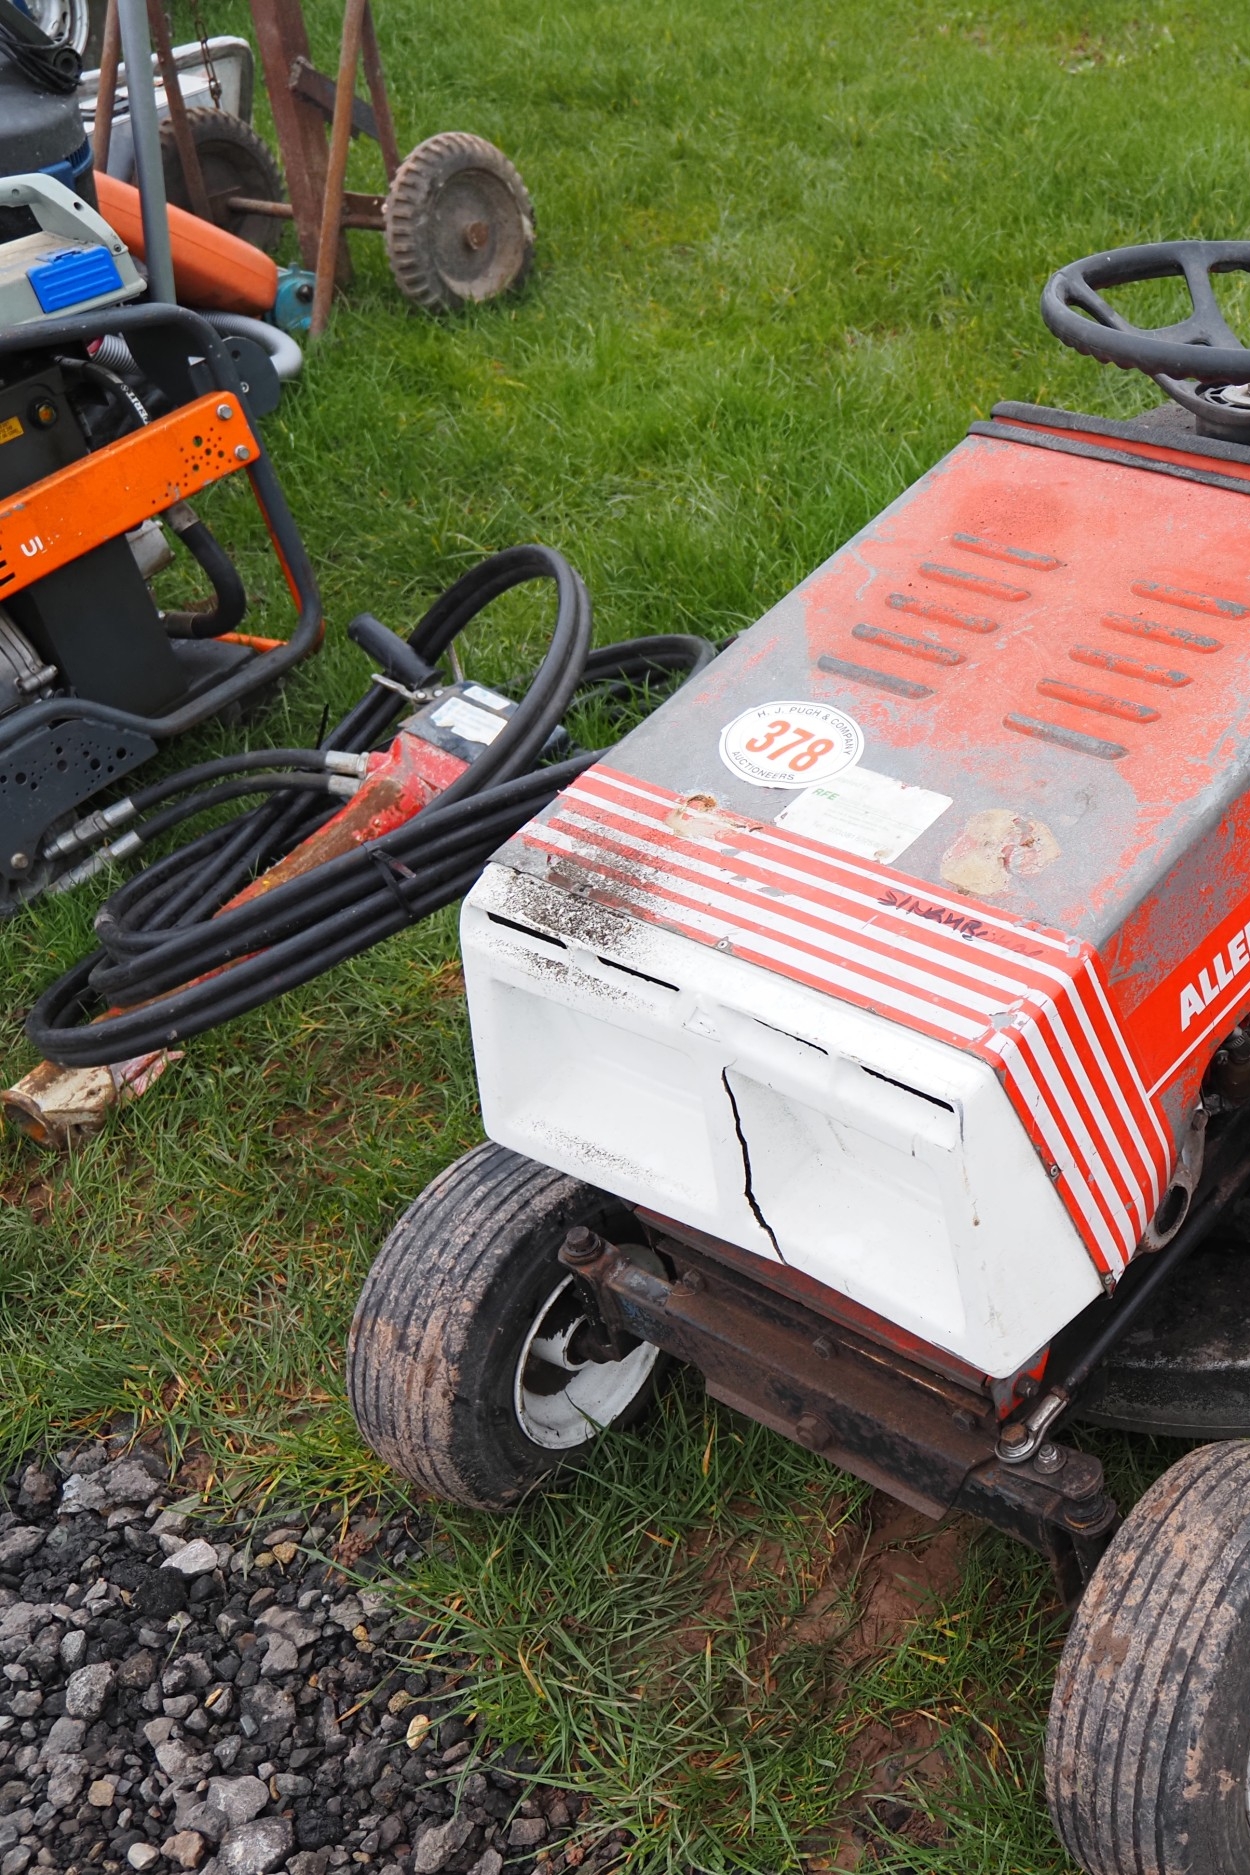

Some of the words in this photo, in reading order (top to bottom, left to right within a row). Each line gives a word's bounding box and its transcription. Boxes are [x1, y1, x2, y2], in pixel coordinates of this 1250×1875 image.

[745, 719, 835, 772] 378
[757, 711, 771, 719] H.
[789, 706, 822, 718] PUGH
[821, 713, 832, 721] &
[830, 717, 853, 756] COMPANY
[731, 750, 795, 781] AUCTIONEERS
